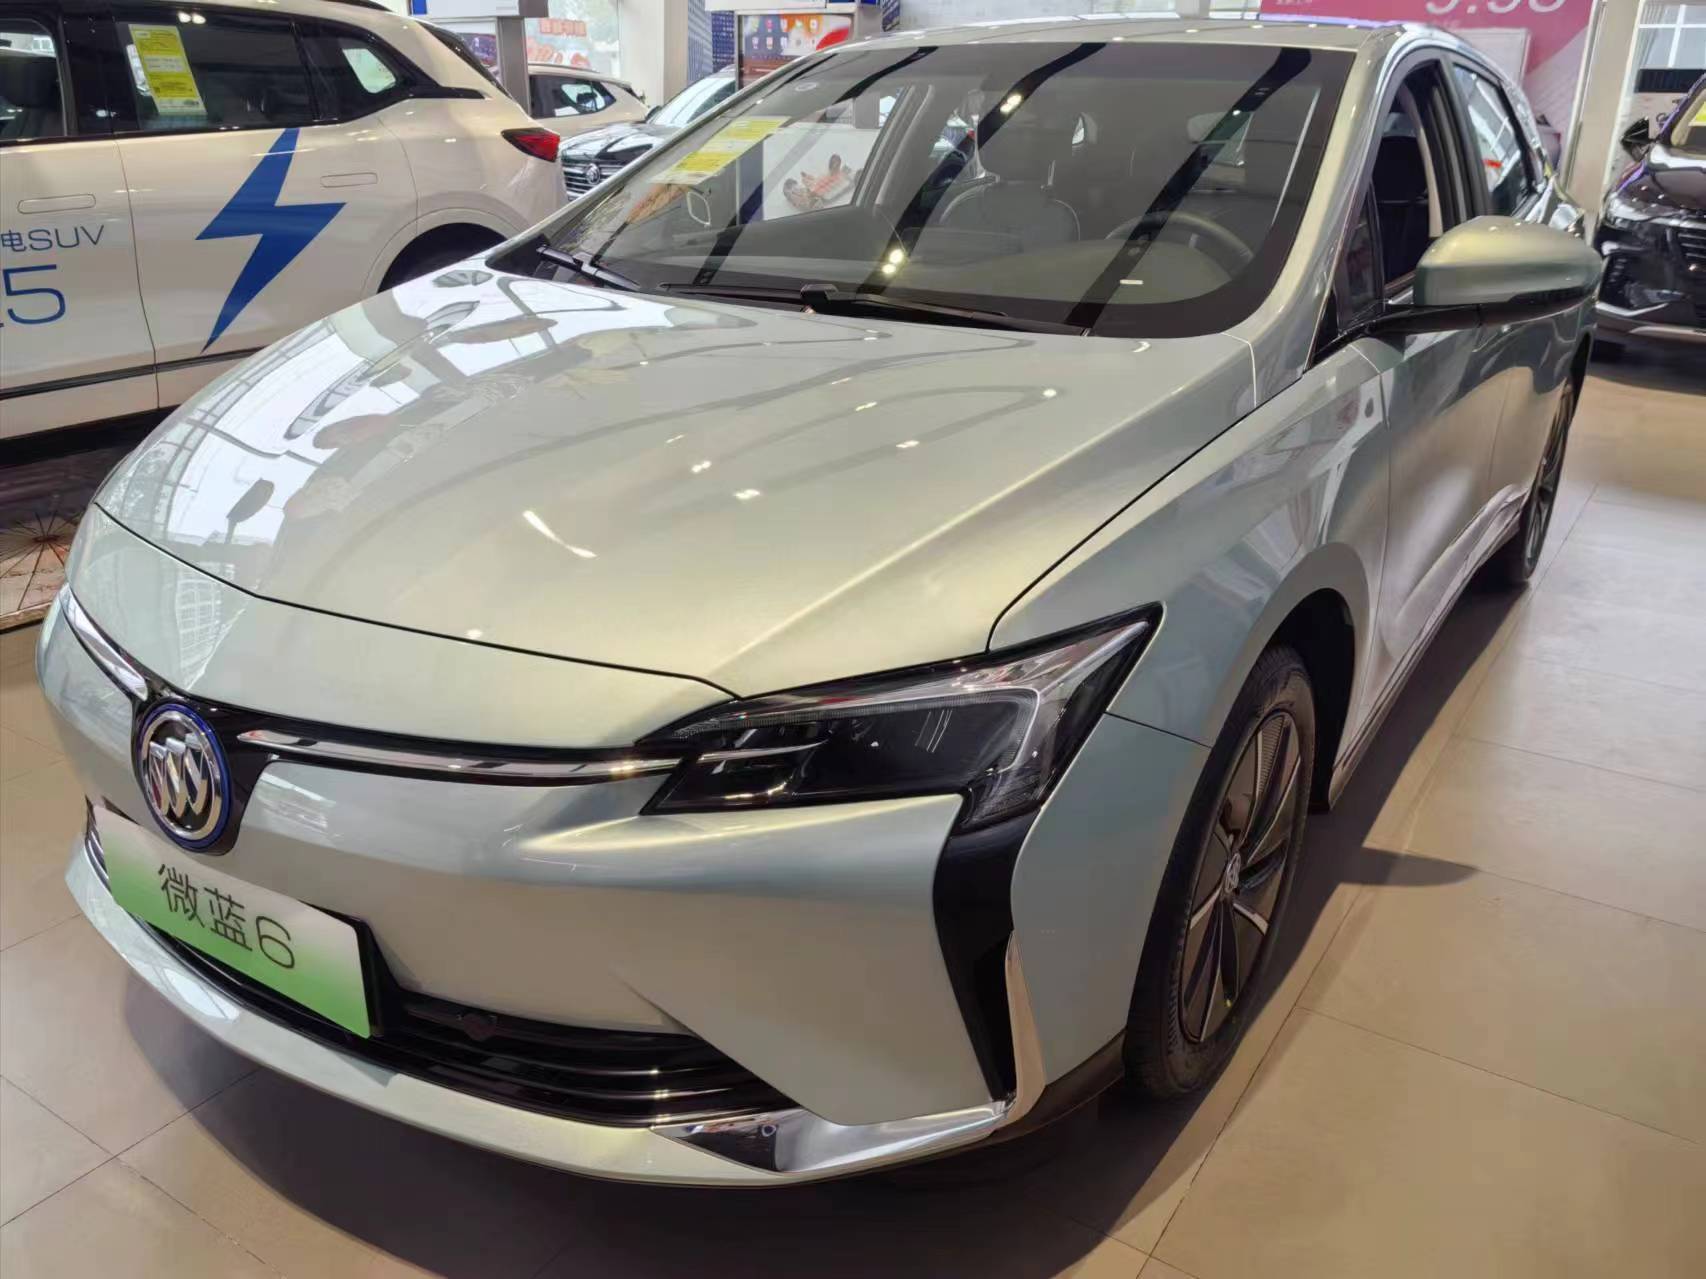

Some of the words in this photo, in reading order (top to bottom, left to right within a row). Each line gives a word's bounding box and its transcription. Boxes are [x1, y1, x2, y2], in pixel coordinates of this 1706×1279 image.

[1, 224, 104, 252] 电SUV
[0, 264, 66, 327] 5
[158, 864, 295, 969] 微蓝6
